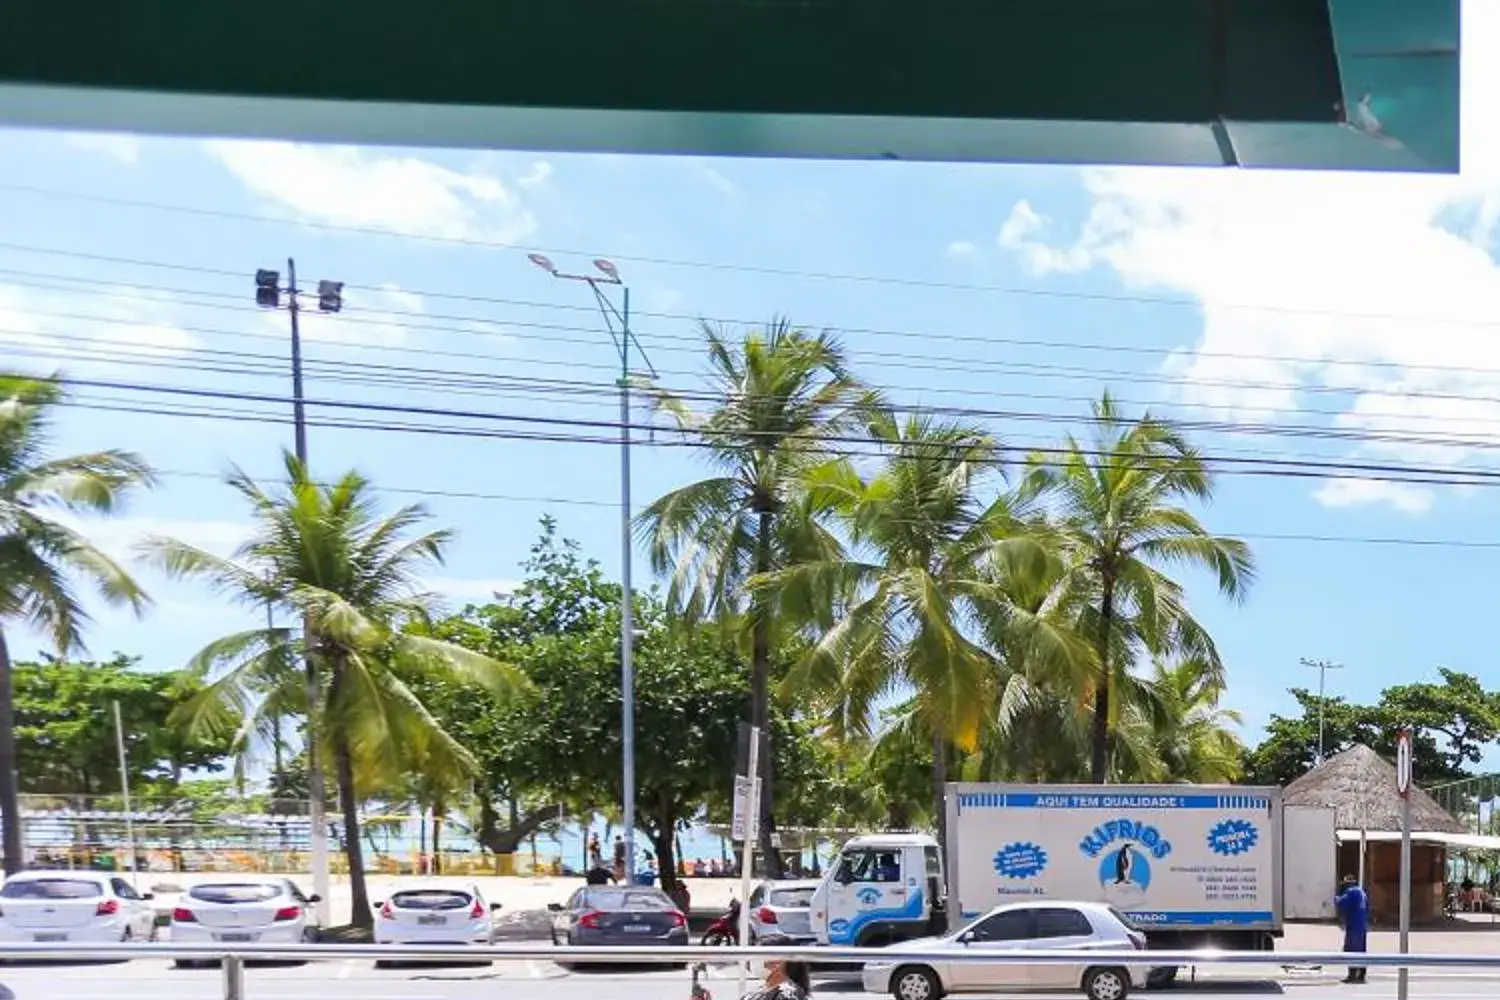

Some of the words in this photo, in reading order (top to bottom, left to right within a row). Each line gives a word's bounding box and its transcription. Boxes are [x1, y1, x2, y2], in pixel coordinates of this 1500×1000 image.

[1036, 796, 1069, 807] AQUI
[1072, 796, 1099, 807] TEM
[1102, 796, 1176, 808] QUALIDADE
